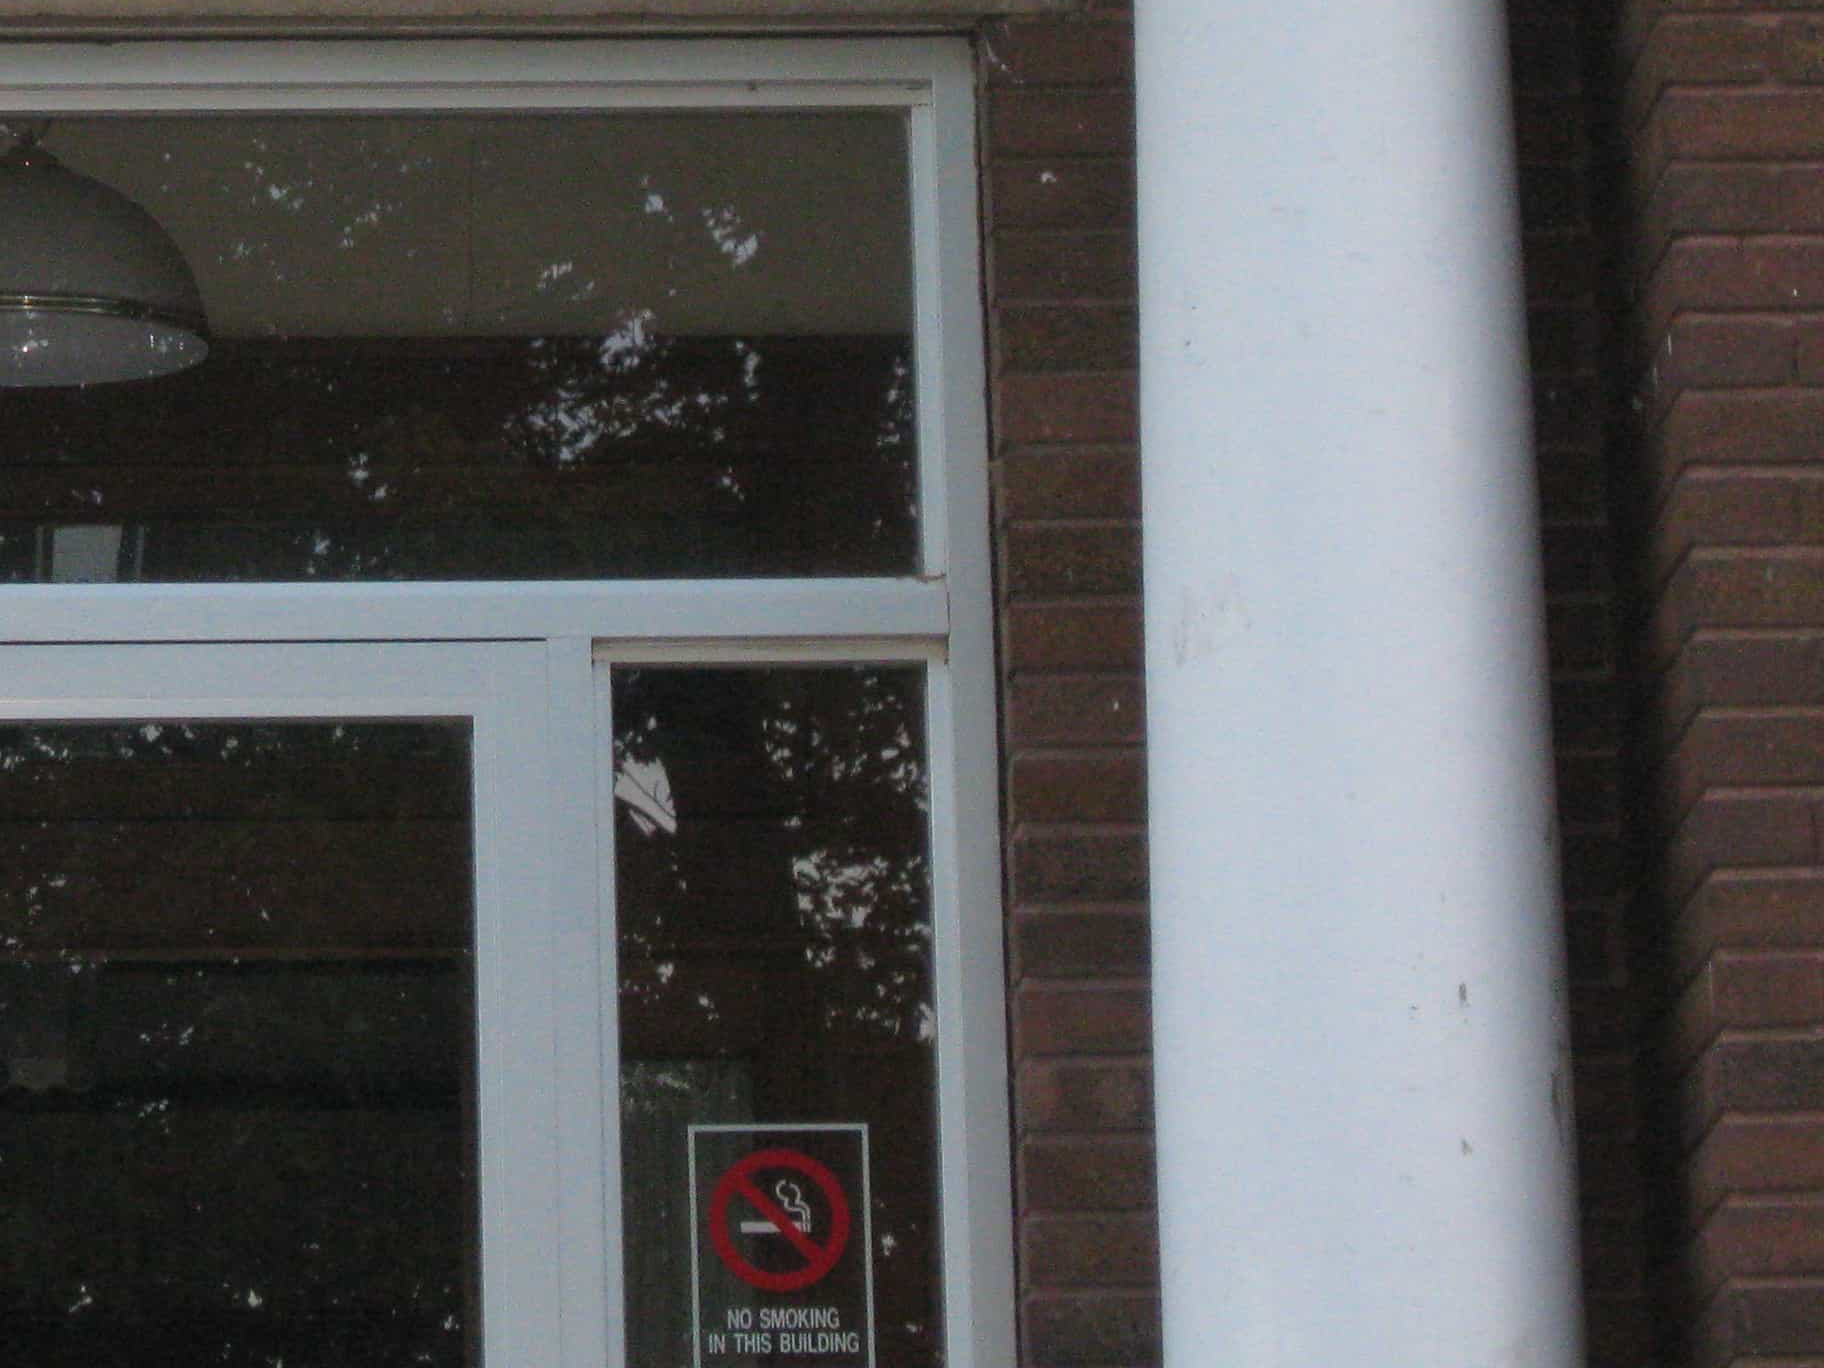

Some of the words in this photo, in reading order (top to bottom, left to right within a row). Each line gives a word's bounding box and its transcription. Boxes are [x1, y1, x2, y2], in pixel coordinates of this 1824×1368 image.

[727, 1308, 753, 1330] NO
[759, 1307, 840, 1329] SMOKING
[708, 1333, 726, 1354] IN
[734, 1333, 772, 1353] THIS
[779, 1332, 860, 1353] BUILDING
